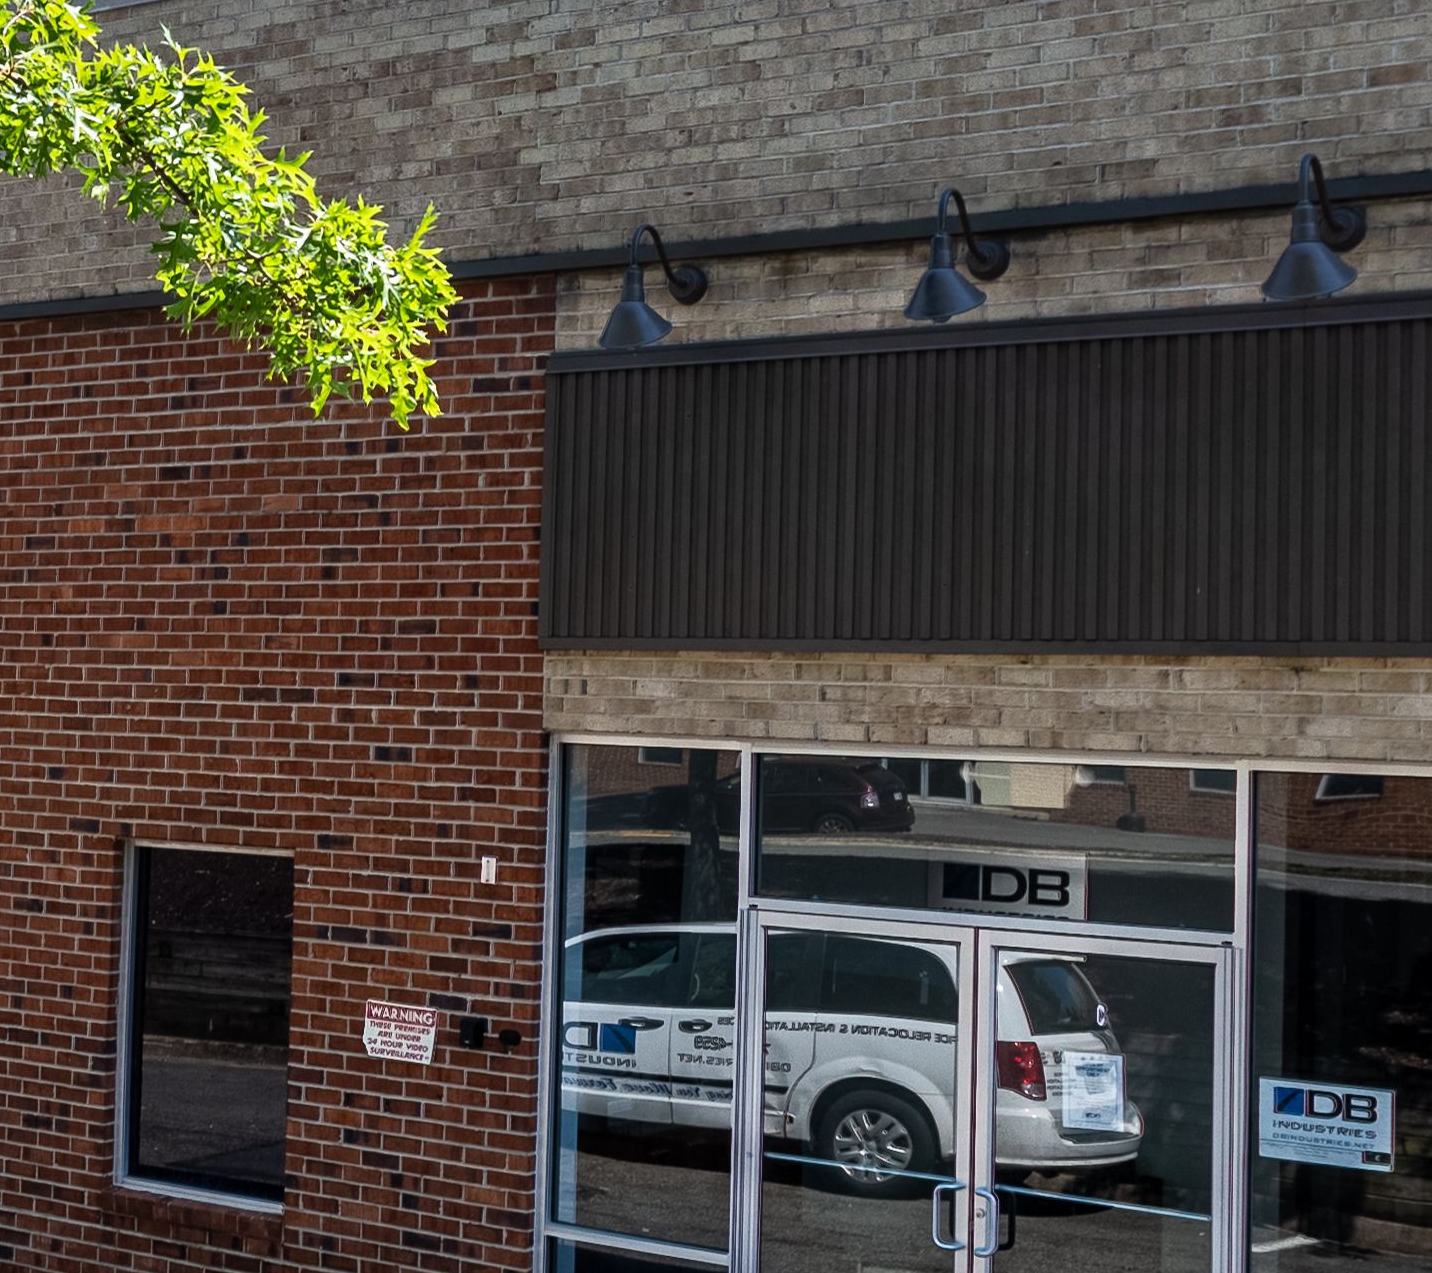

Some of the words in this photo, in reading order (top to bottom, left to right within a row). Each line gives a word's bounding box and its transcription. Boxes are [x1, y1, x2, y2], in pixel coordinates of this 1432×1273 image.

[981, 865, 1070, 907] DB
[370, 1005, 433, 1024] WARNING
[369, 1020, 392, 1029] THESE
[394, 1024, 431, 1035] PREMISES
[377, 1029, 393, 1039] ARE
[395, 1033, 421, 1043] UNDER
[367, 1037, 378, 1045] 24
[380, 1040, 404, 1049] HOUR
[406, 1043, 429, 1053] VIDEO
[370, 1046, 424, 1061] SURVEILLANCE
[1304, 1089, 1378, 1124] DB
